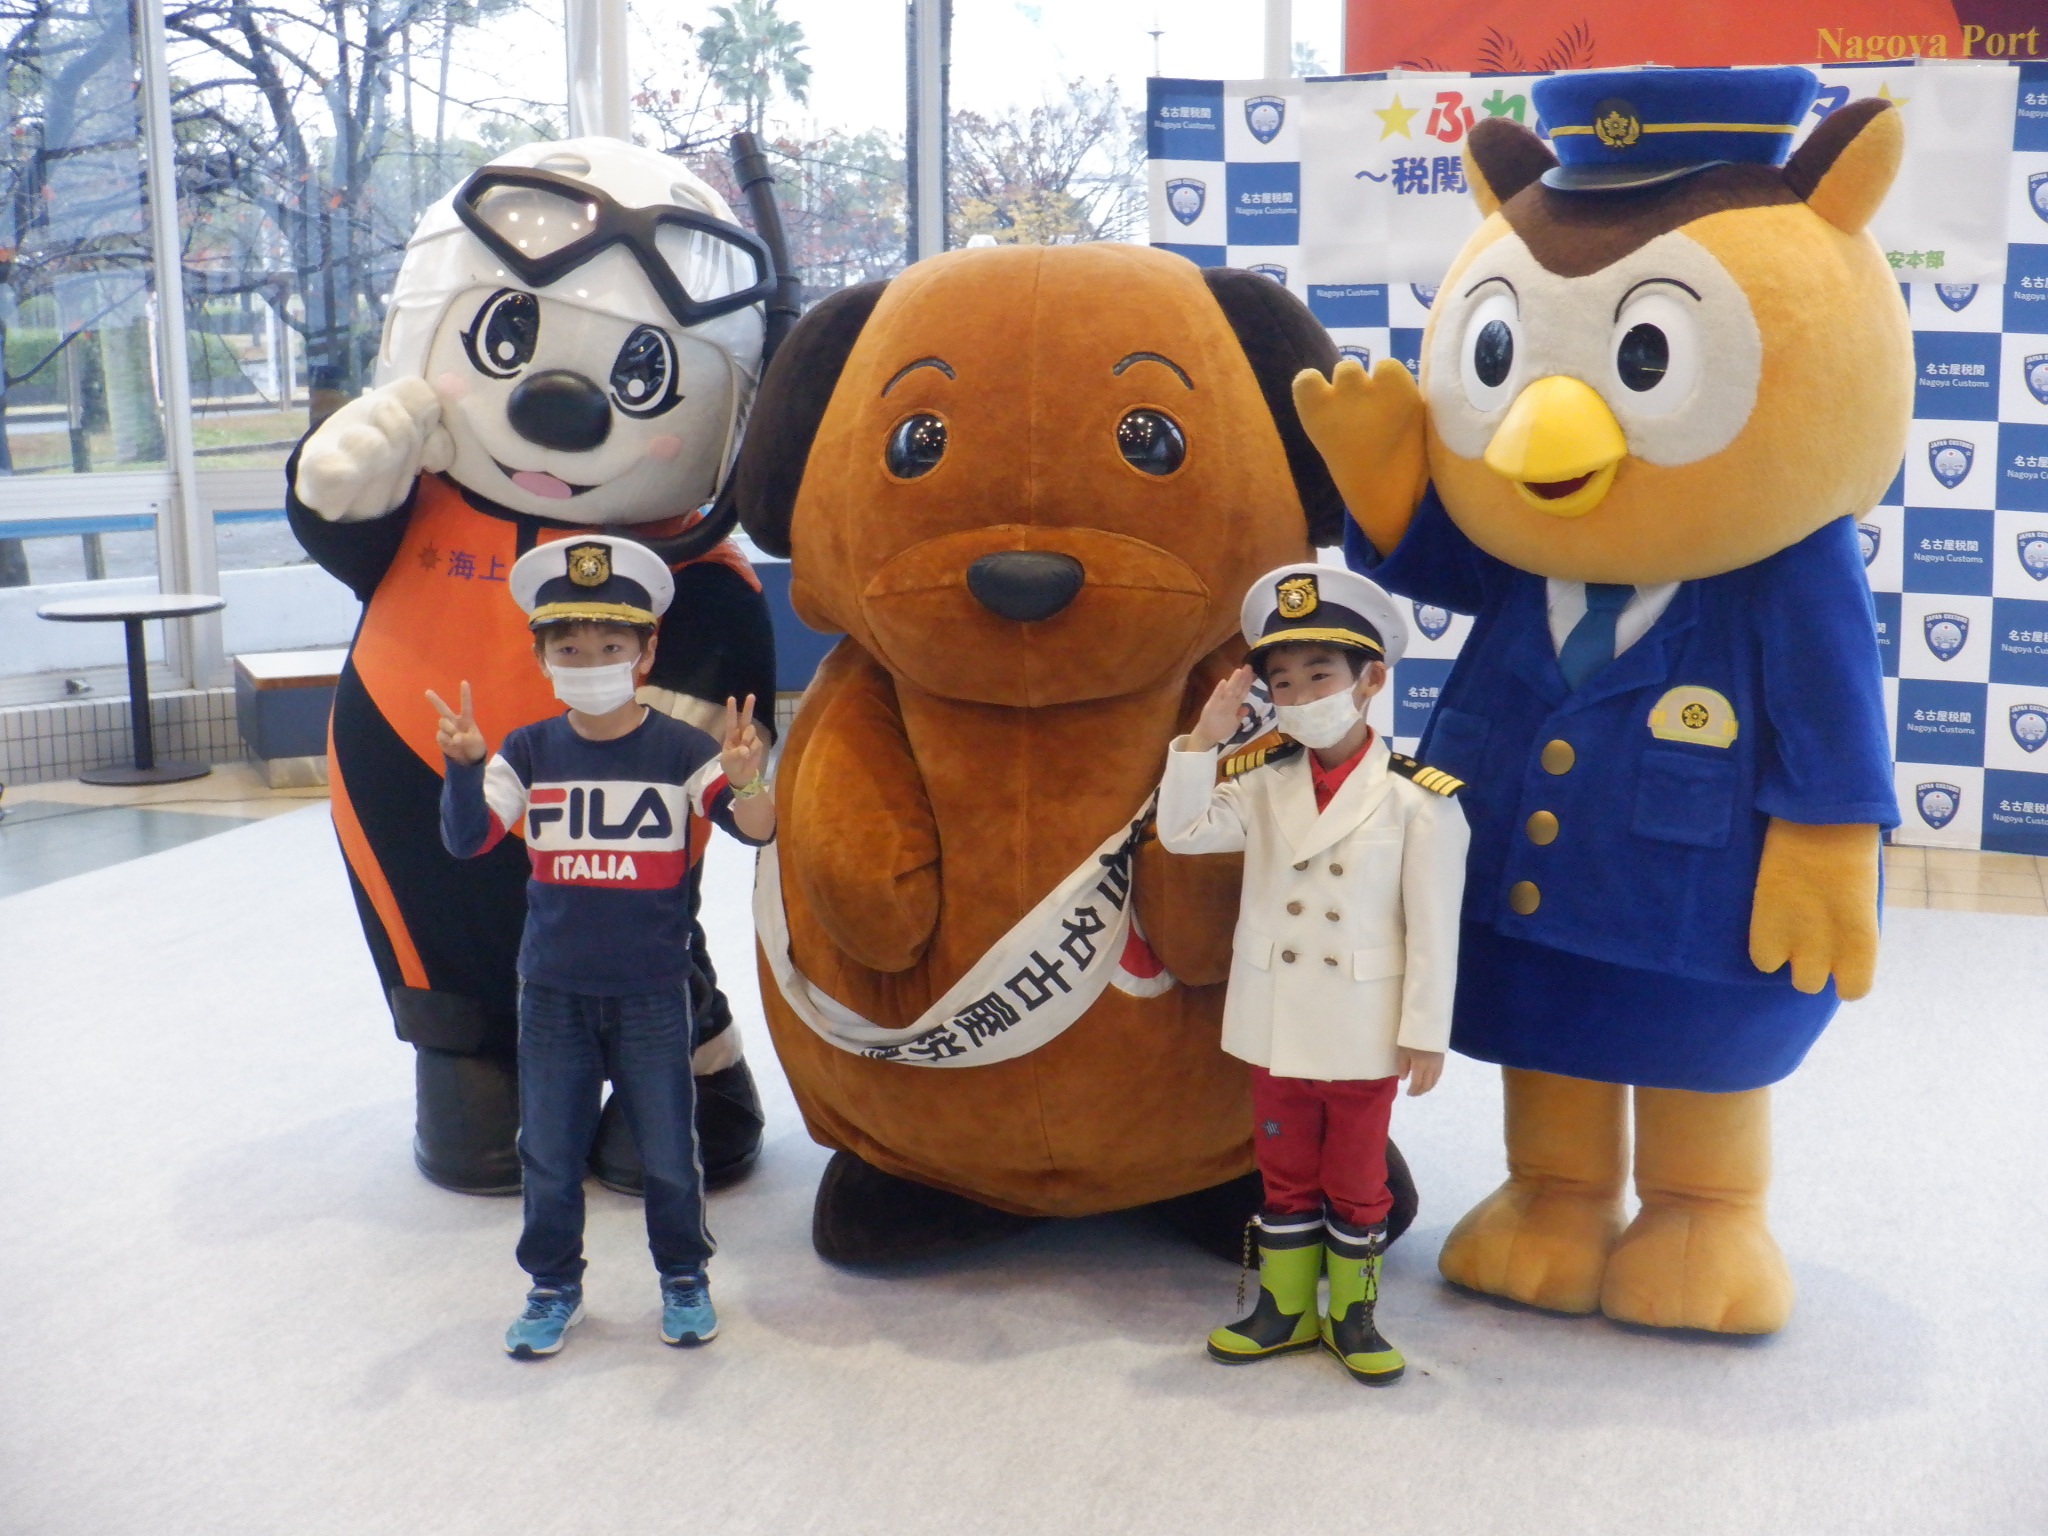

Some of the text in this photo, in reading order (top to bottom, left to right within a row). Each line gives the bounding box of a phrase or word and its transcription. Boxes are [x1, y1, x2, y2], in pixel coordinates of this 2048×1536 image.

[1816, 24, 2041, 60] Nagoya Port
[1160, 106, 1211, 119] 名古屋税関
[1154, 120, 1216, 130] Nagoya Customs
[1241, 192, 1293, 204] 名古屋税関
[1235, 206, 1298, 216] Nagoya Customs
[1316, 288, 1380, 299] Nagoya Customs
[2013, 291, 2046, 302] Nagoya
[1926, 362, 1985, 376] 名古屋税関
[1919, 377, 1990, 388] Nagoya Customs
[2006, 469, 2038, 480] Nagoya
[1920, 538, 1979, 552] 名古屋税関
[1913, 552, 1984, 564] Nagoya Customs
[447, 550, 506, 581] 海上
[2001, 643, 2032, 654] Nagoya
[1408, 687, 1442, 698] 名古屋
[1402, 699, 1430, 710] Nagoya
[1913, 709, 1972, 724] 名古屋税関
[1907, 722, 1976, 735] Nagoya Customs
[528, 787, 673, 840] FILA
[1999, 800, 2048, 815] 名古屋税
[1992, 813, 2024, 824] Nagoya
[553, 855, 637, 880] ITALIA
